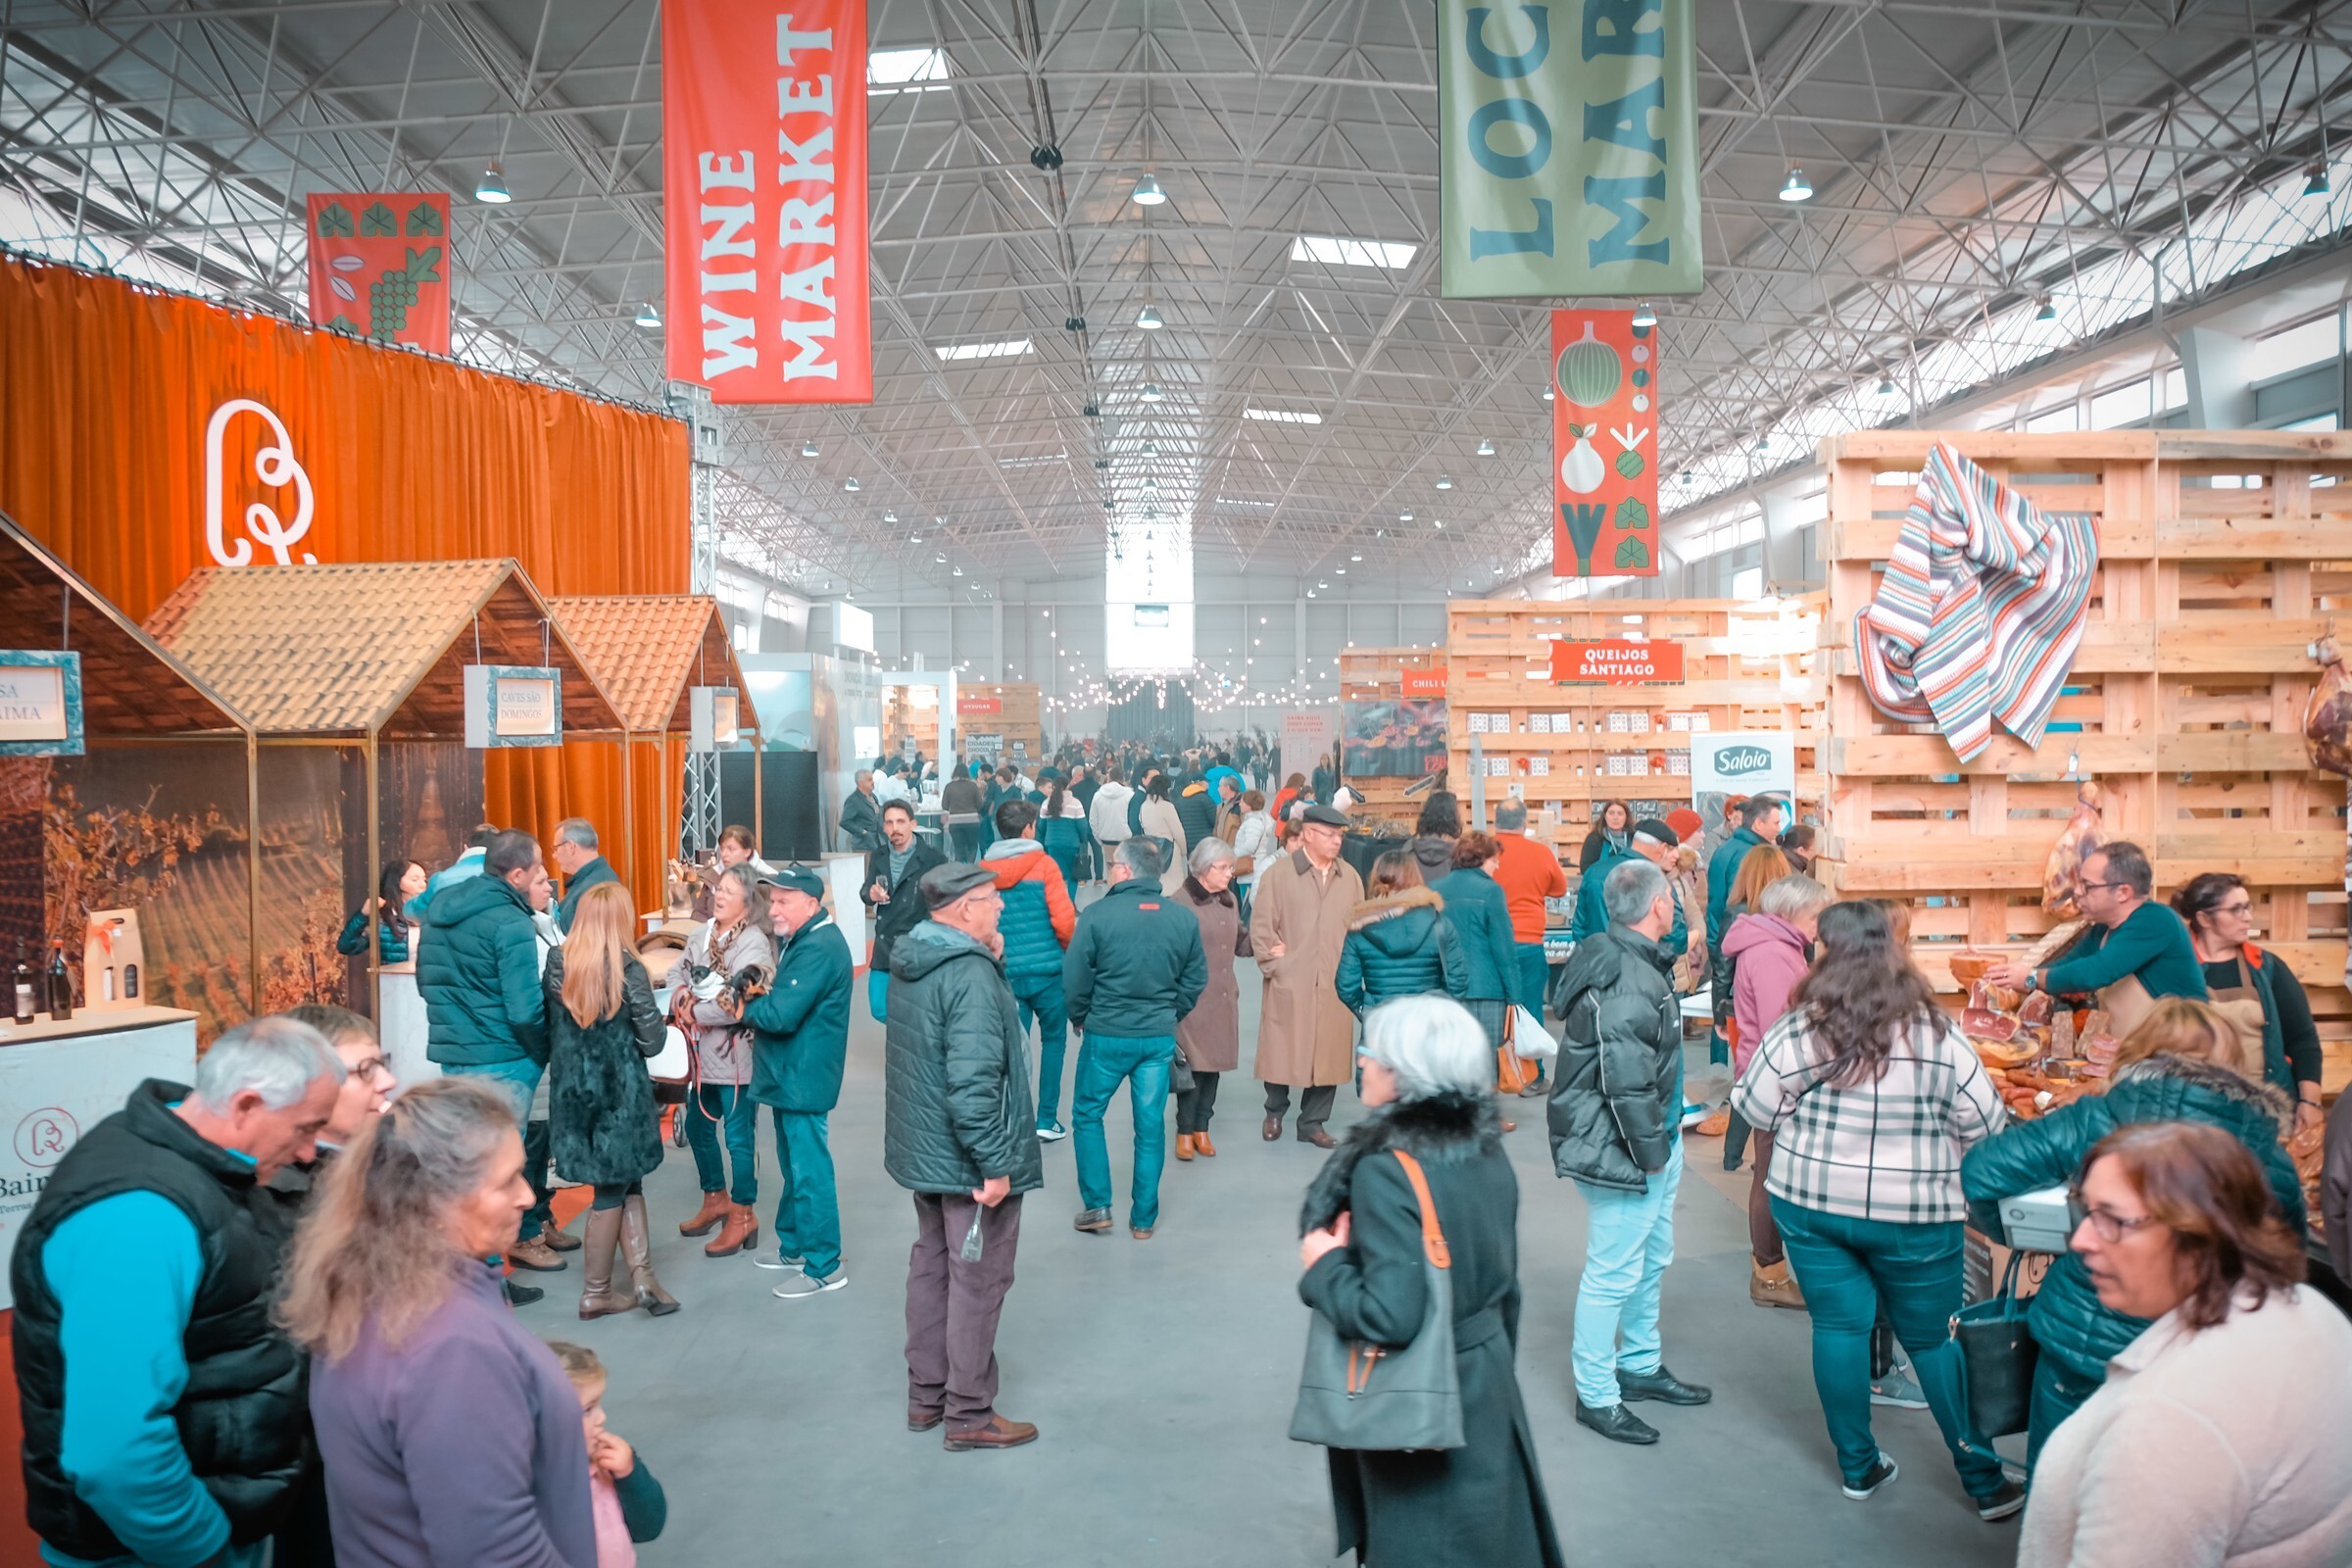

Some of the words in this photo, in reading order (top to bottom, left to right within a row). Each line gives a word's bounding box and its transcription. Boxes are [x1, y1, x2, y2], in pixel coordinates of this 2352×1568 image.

[776, 14, 838, 382] MARKET
[699, 150, 758, 381] WINE
[1584, 649, 1648, 663] QUEIJOS
[1579, 663, 1654, 675] SANTIAGO
[1412, 679, 1439, 688] CHILI
[501, 692, 525, 703] CAVES
[0, 706, 41, 719] IMA
[501, 710, 543, 719] DOMINGOS
[1718, 749, 1767, 771] Saloio
